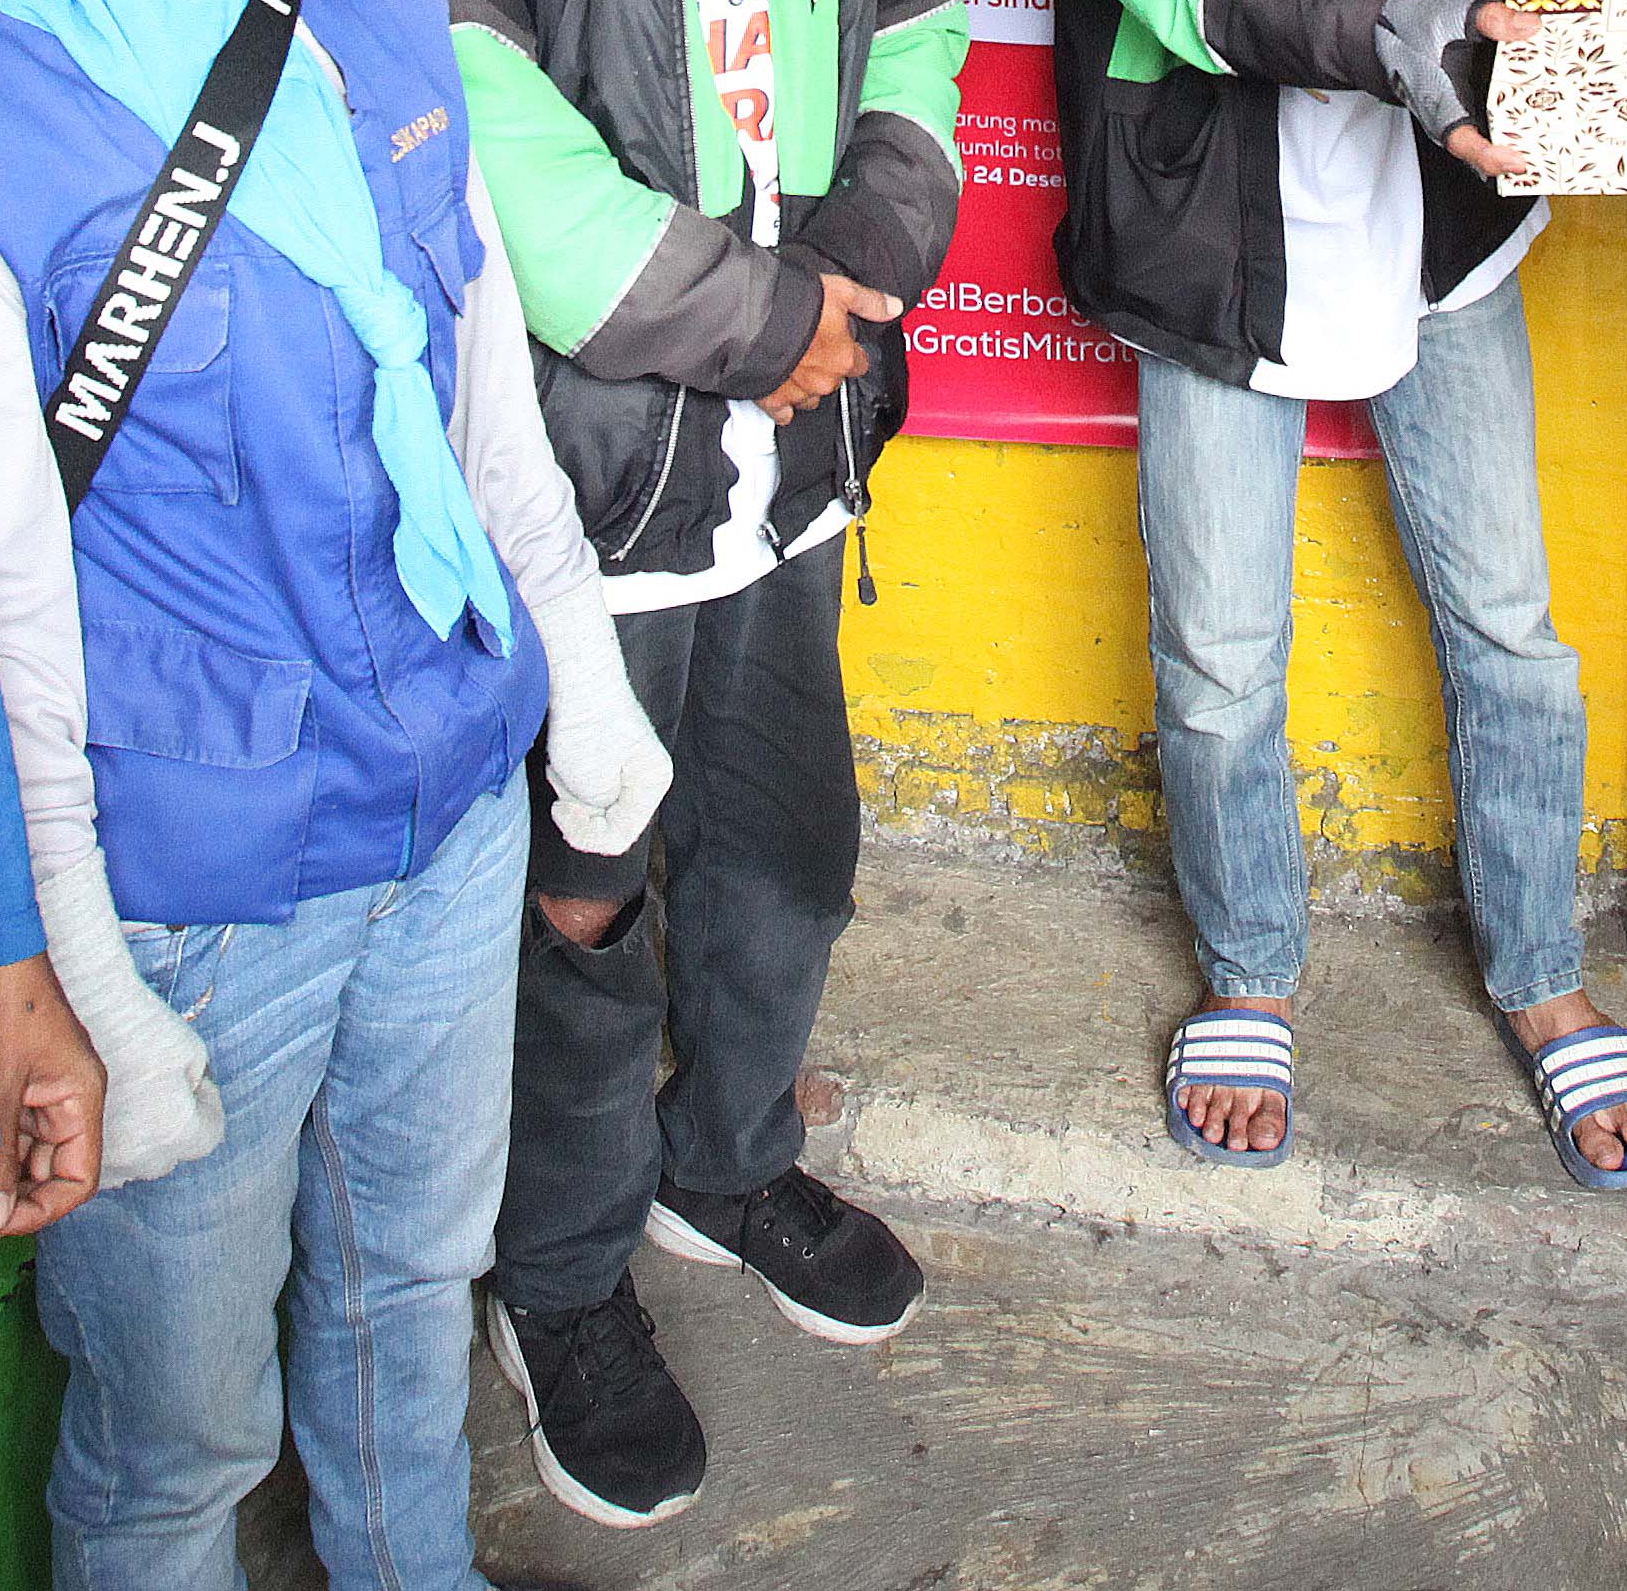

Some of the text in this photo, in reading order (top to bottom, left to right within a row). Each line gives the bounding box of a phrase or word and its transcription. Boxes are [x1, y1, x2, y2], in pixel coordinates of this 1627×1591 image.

[1023, 118, 1061, 134] ma
[973, 165, 1003, 185] 24
[54, 119, 242, 442] MARHEN.J
[902, 324, 1140, 363] GratisMitrat
